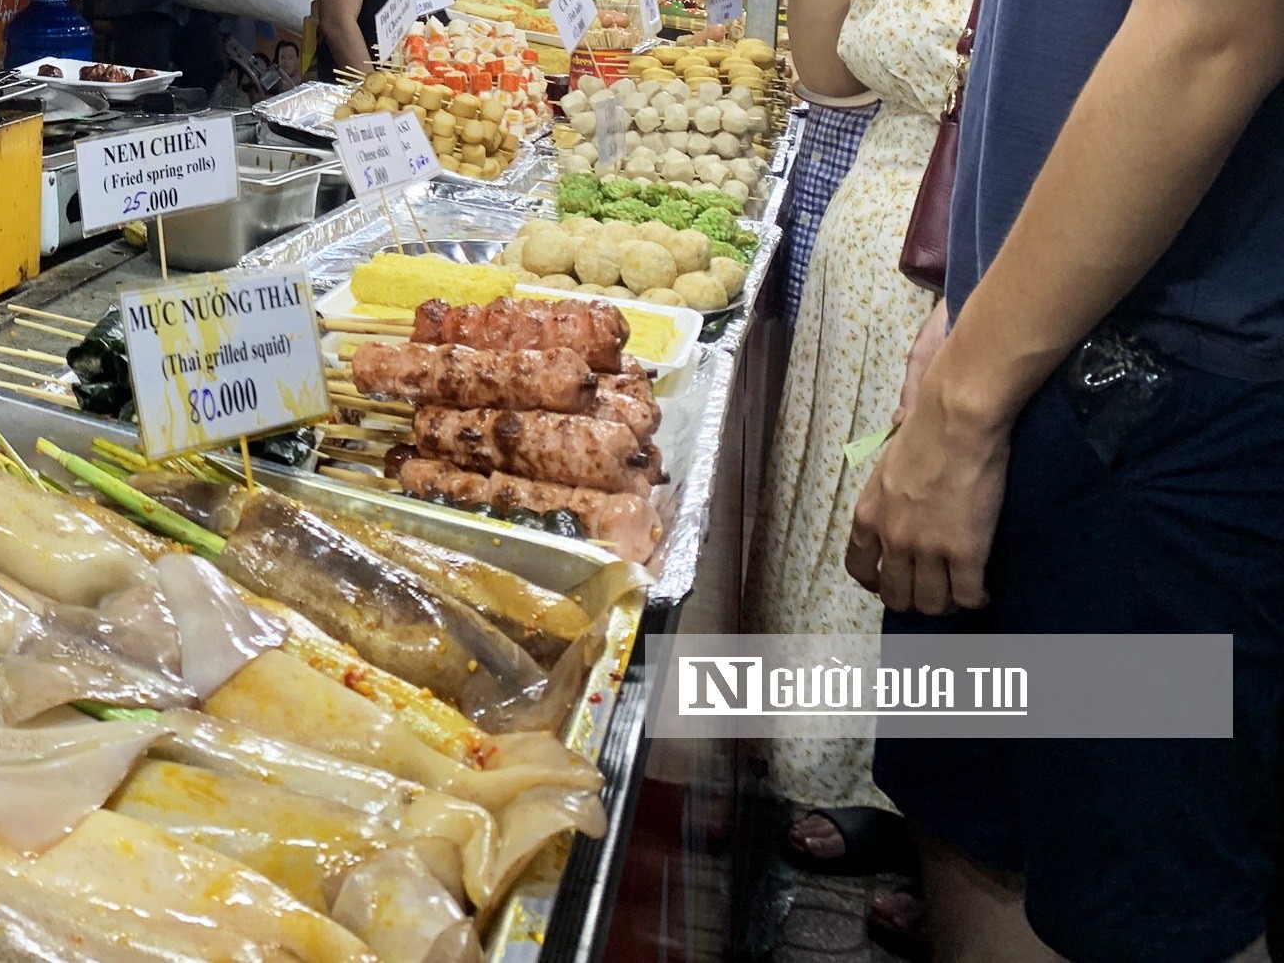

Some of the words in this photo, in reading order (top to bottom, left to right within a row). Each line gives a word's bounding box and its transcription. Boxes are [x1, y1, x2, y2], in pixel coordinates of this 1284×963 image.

[102, 140, 146, 166] NEM
[150, 126, 208, 157] CHIÊN
[146, 164, 184, 185] spring
[187, 155, 216, 173] rolls)
[122, 187, 179, 215] 25.000
[128, 298, 177, 335] MỰC
[180, 286, 253, 324] NƯỚNG
[255, 277, 302, 312] THÁI
[161, 349, 202, 381] (Thai
[205, 340, 249, 374] grilled
[251, 333, 292, 367] squid)
[187, 377, 259, 424] 80.000
